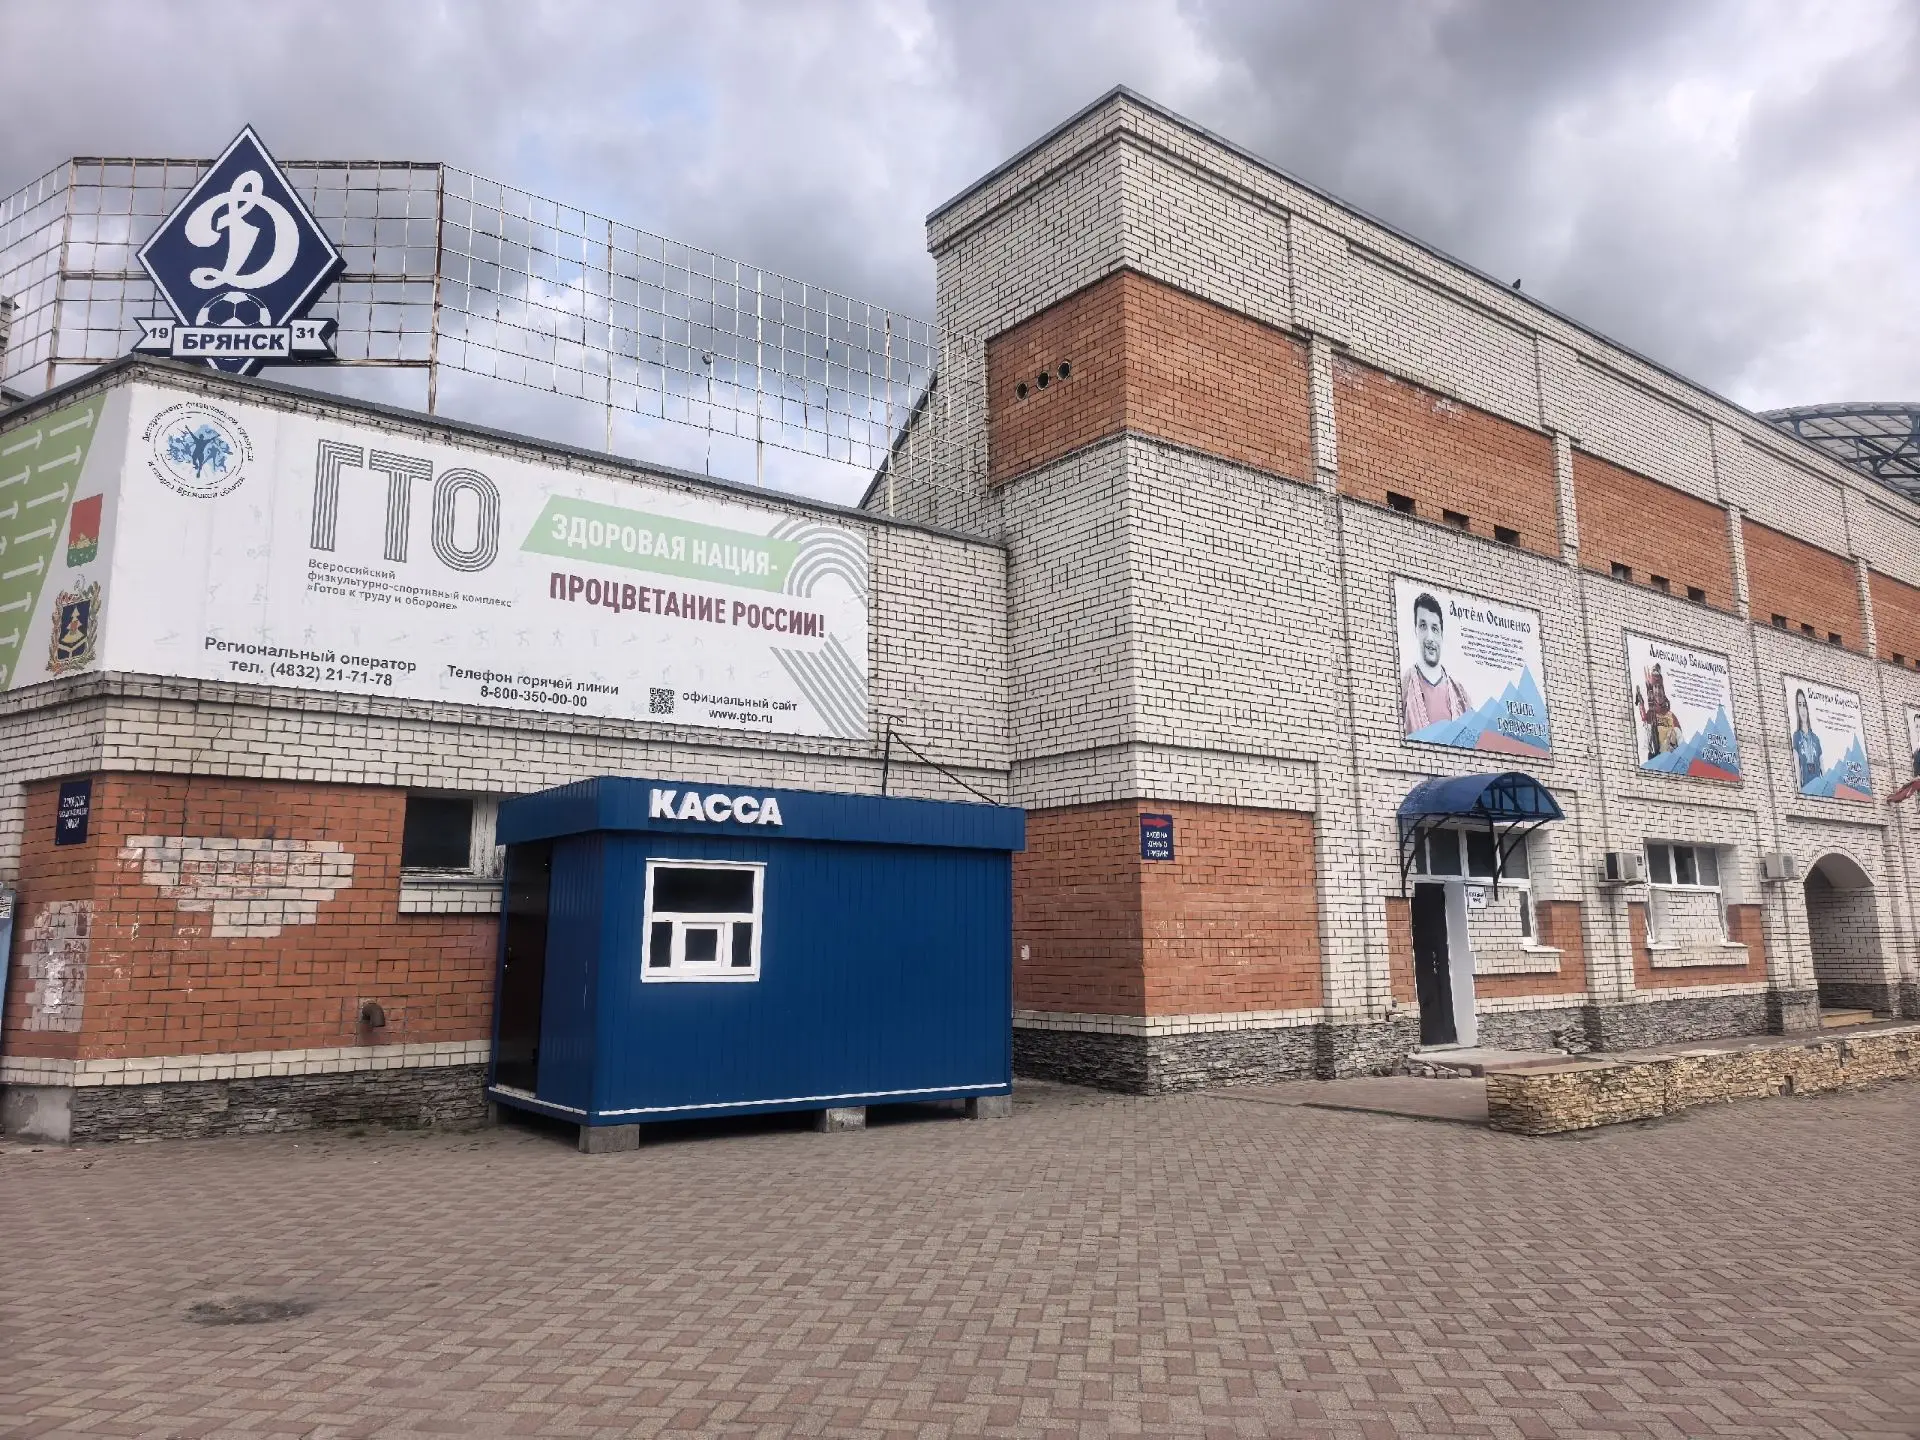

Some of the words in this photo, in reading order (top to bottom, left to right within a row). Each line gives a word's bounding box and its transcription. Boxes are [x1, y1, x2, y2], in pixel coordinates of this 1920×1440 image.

[149, 327, 169, 339] 19
[295, 327, 315, 339] 31
[181, 332, 285, 351] БРЯНСК
[310, 438, 501, 572] ГТО
[551, 513, 686, 562] ЗДОРОВАЯ
[308, 558, 396, 580] Всероссийский
[307, 571, 459, 601] физкультурно-спортивный
[462, 592, 512, 608] комплекс
[349, 588, 357, 597] к
[359, 591, 392, 605] труду
[394, 596, 402, 604] и
[405, 596, 458, 611] обороне»
[550, 572, 727, 624] ПРОЦВЕТАНИЕ
[732, 601, 825, 638] РОССИИ!
[1449, 600, 1485, 624] Артём
[204, 637, 335, 663] Региональный
[340, 654, 417, 673] оператор
[229, 660, 264, 674] тел.
[270, 662, 321, 682] (4832)
[325, 667, 393, 687] 21-71-78
[447, 664, 512, 684] Телефон
[517, 674, 573, 691] горячей
[576, 682, 619, 696] линии
[480, 685, 588, 707] 8-800-350-00-00
[682, 691, 769, 710] официальный
[772, 699, 798, 711] сайт
[708, 709, 773, 724] www.gto.ru
[648, 788, 783, 827] КАССА
